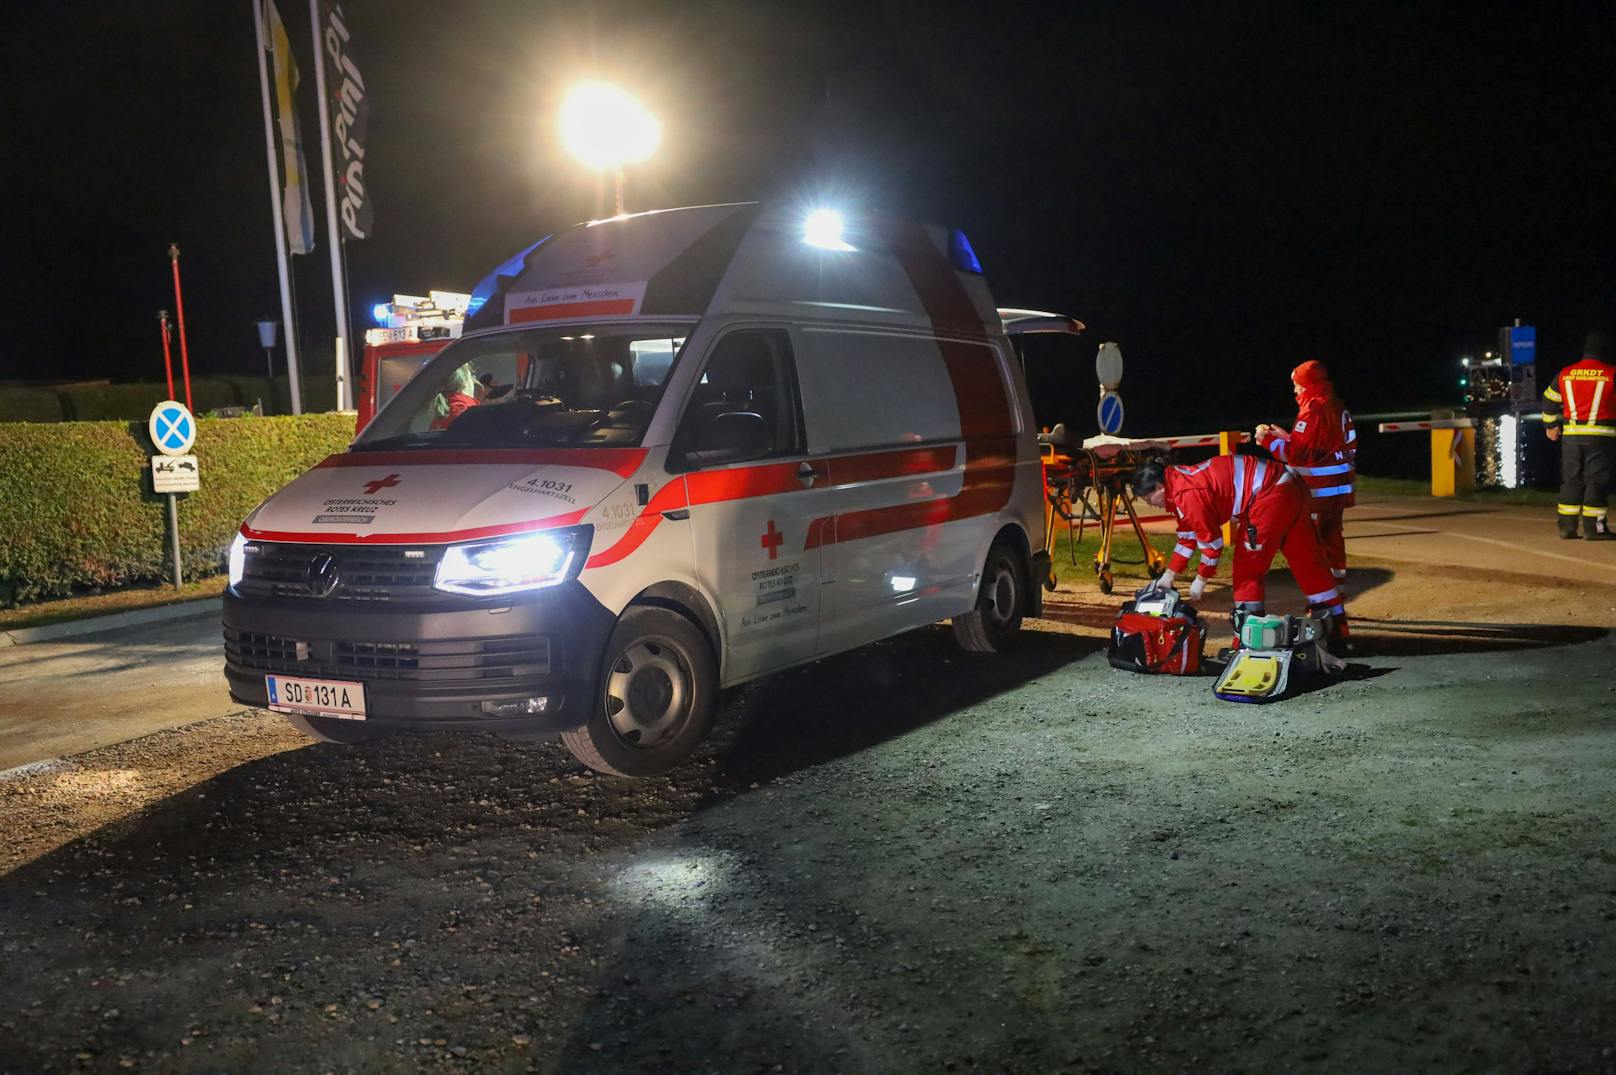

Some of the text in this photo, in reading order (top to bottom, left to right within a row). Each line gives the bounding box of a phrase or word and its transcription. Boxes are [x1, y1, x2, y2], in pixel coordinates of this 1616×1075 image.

[541, 294, 560, 303] Liebe
[508, 484, 577, 504] ENGELHARTSZELL
[527, 478, 573, 493] 4.1031
[285, 682, 302, 703] SD
[314, 685, 337, 707] 131
[342, 688, 351, 708] A
